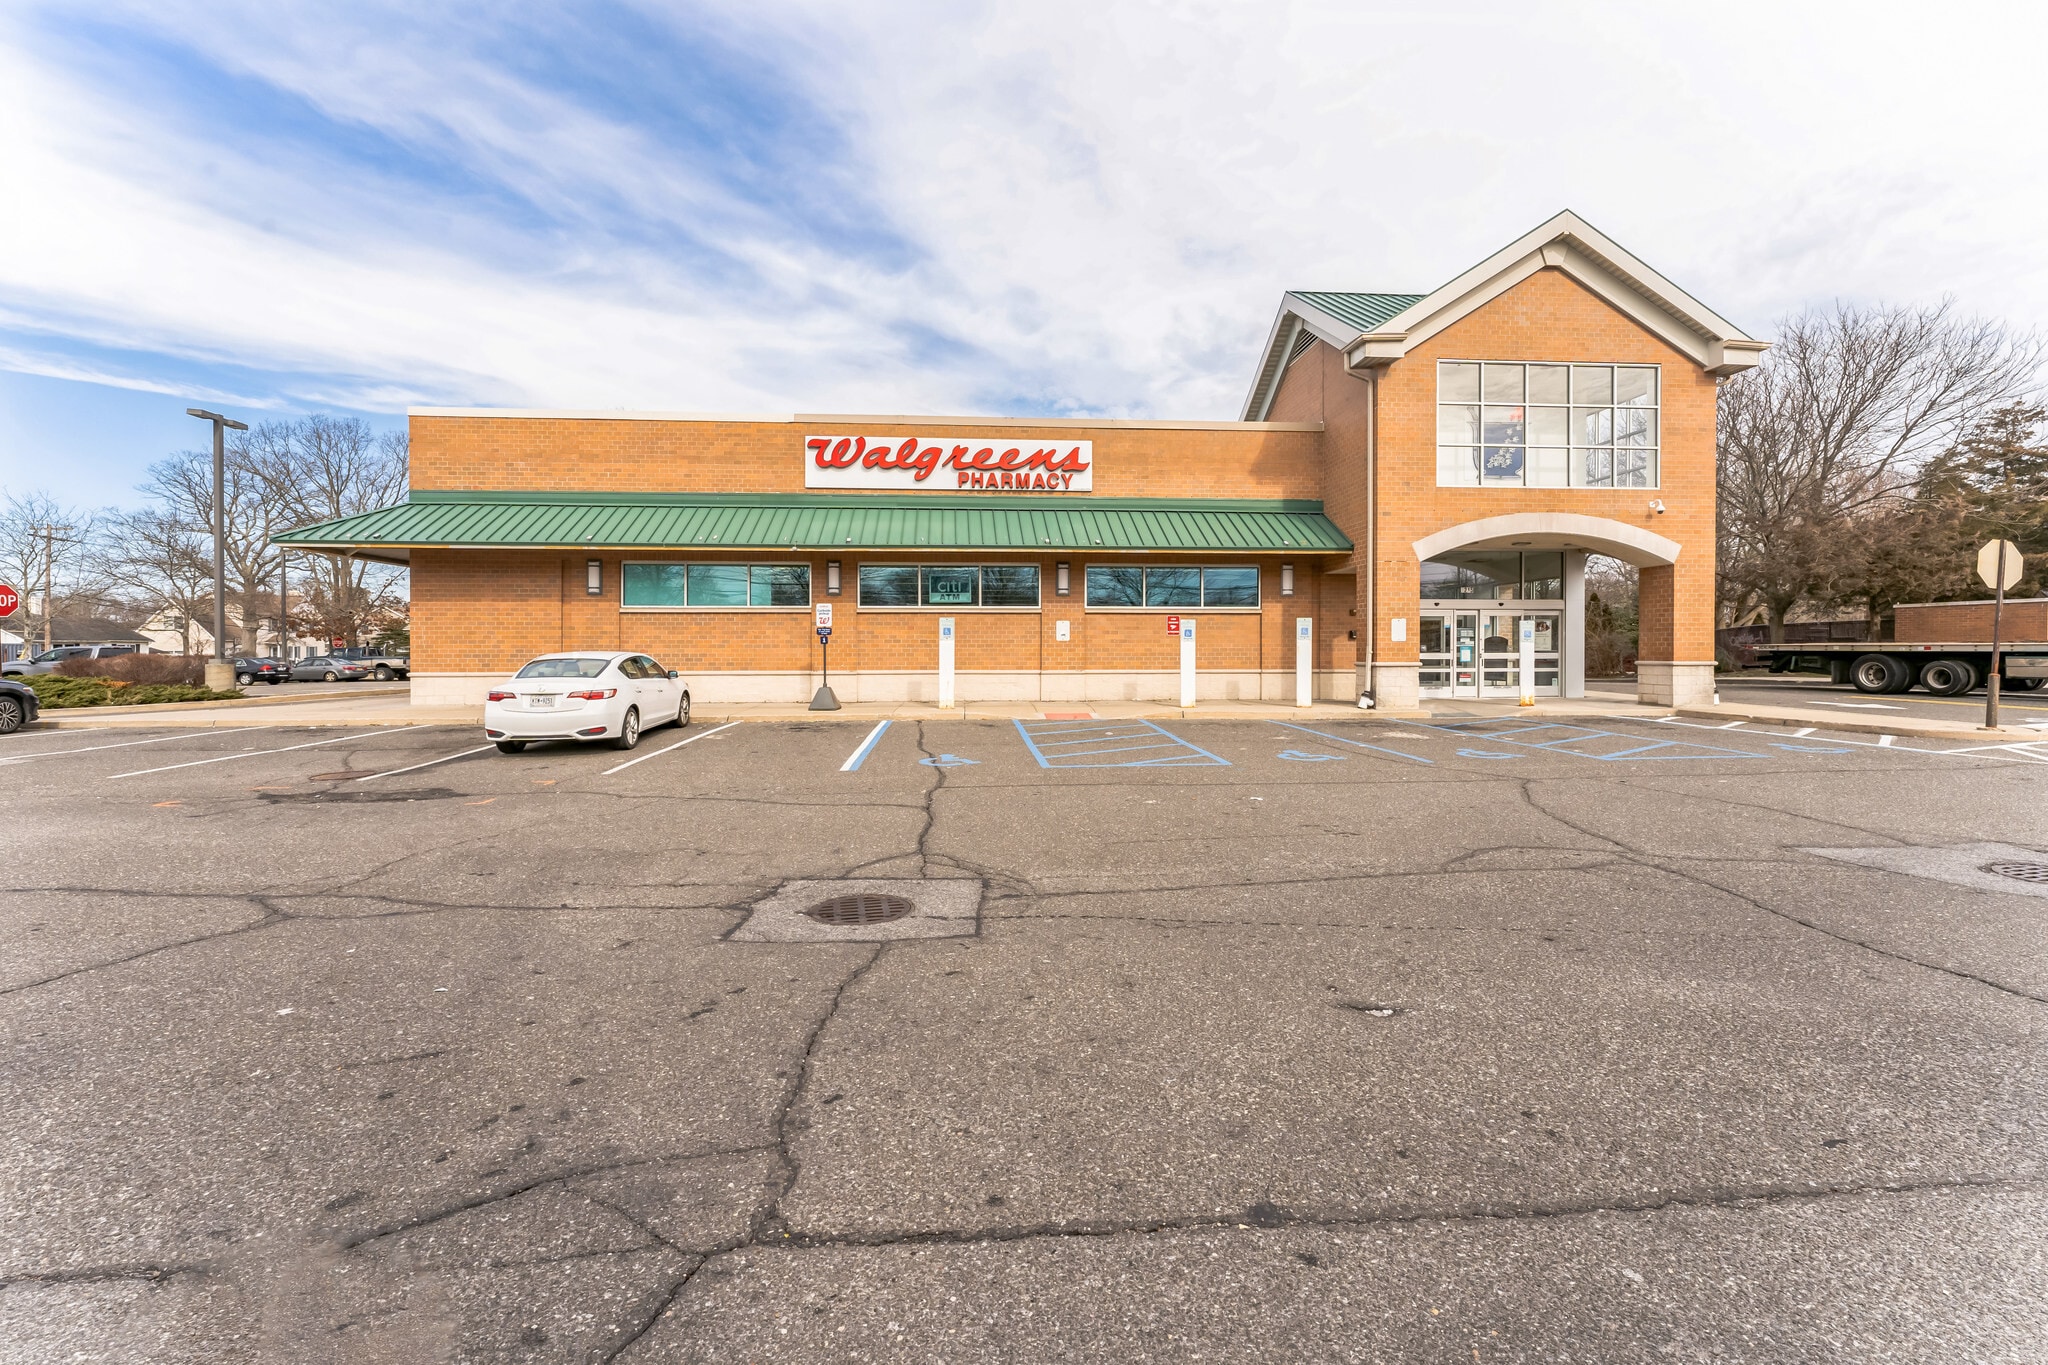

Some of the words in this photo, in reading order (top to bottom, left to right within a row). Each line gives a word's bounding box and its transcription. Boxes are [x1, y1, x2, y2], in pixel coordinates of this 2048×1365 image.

[807, 436, 1090, 481] Walgreens
[958, 471, 1073, 489] PHARMACY
[937, 580, 961, 592] citi
[0, 595, 17, 607] OP
[940, 593, 960, 601] ATM
